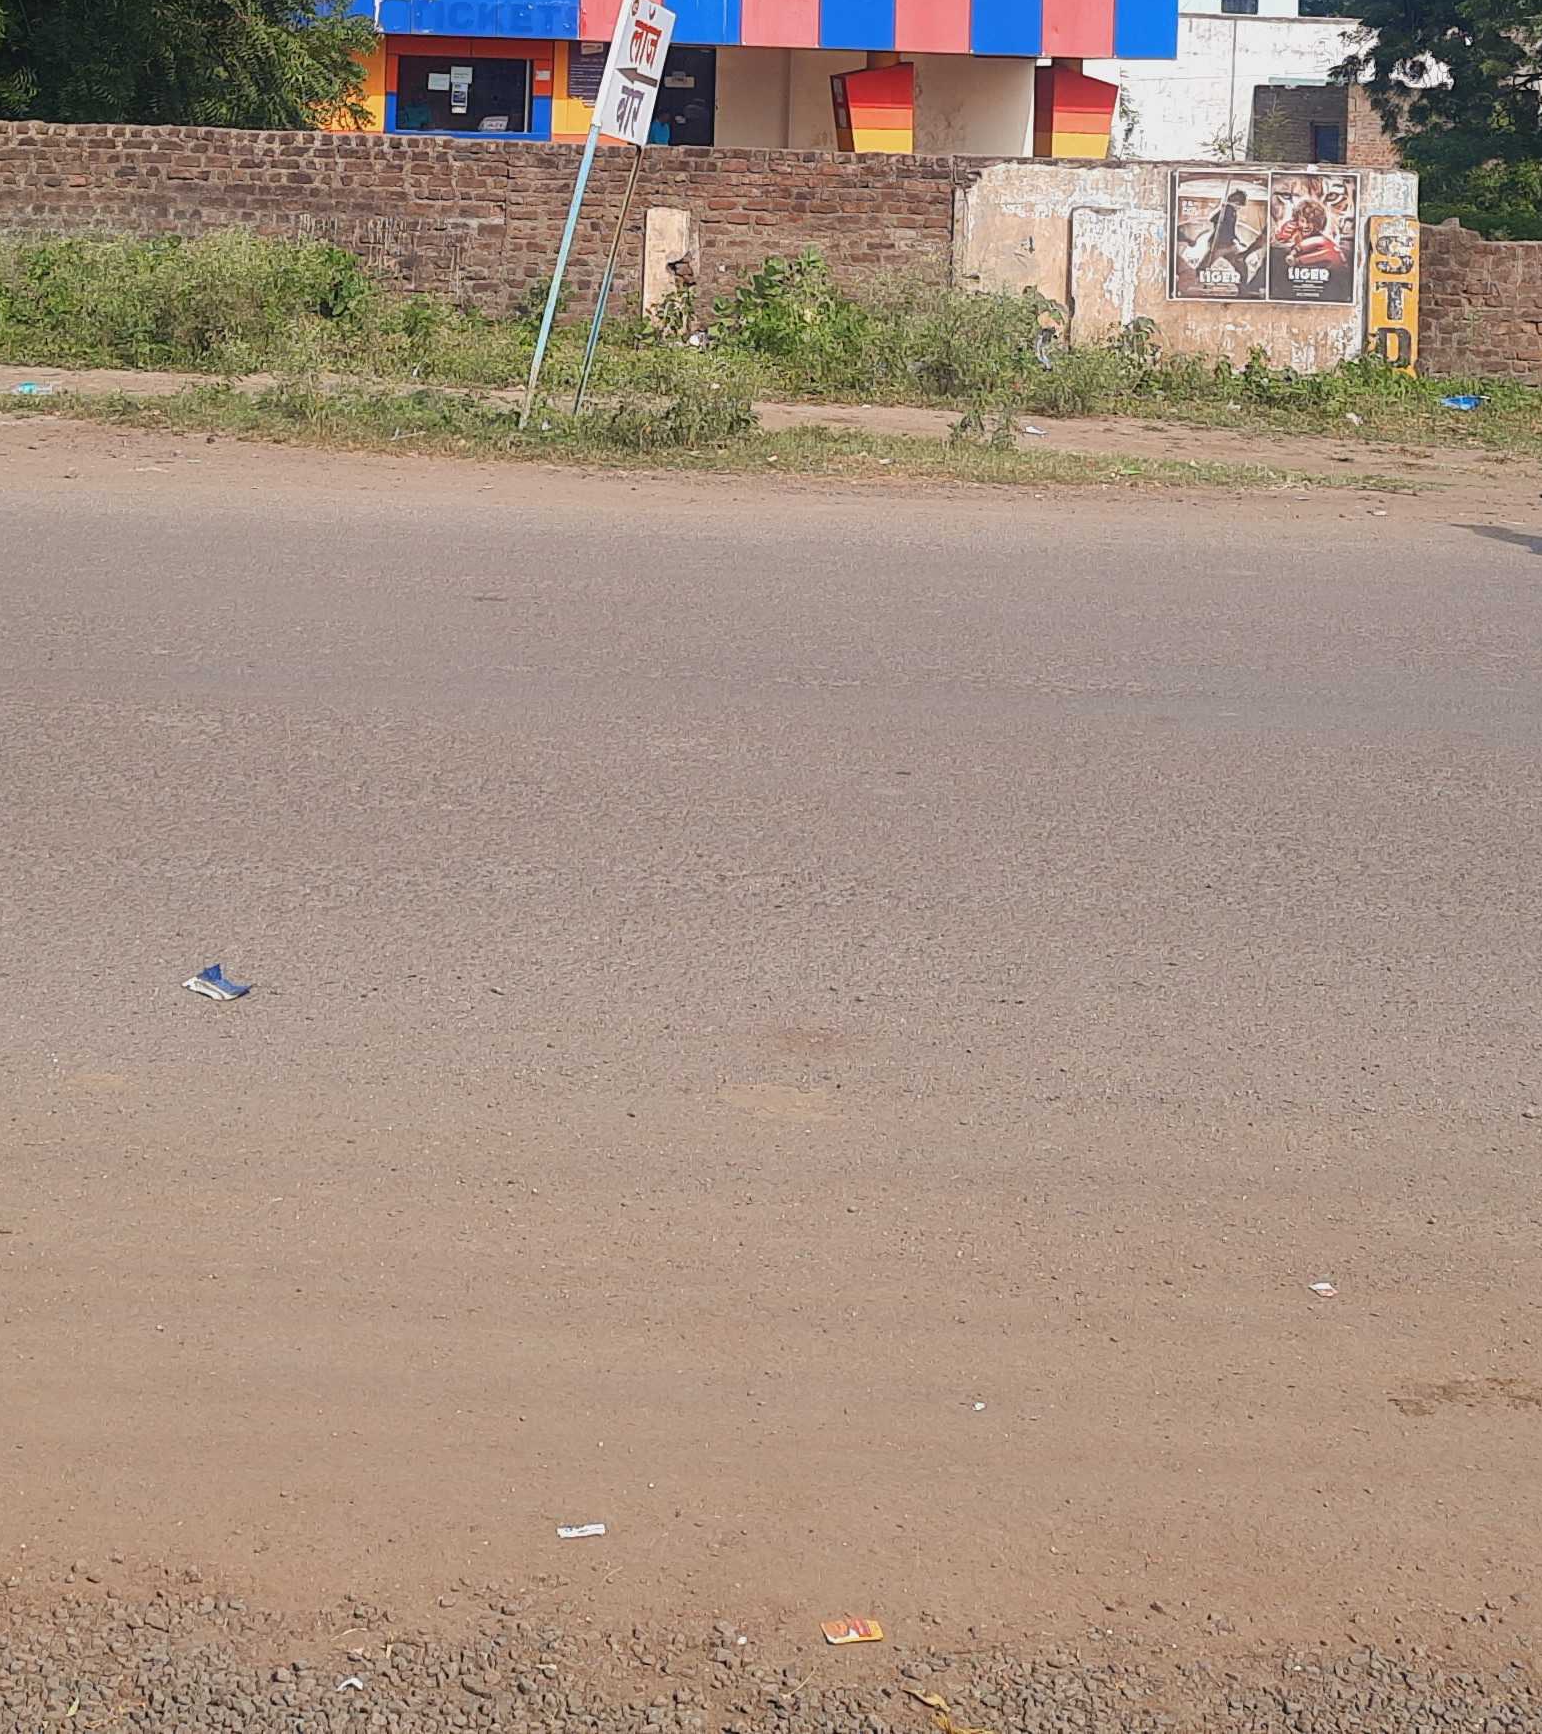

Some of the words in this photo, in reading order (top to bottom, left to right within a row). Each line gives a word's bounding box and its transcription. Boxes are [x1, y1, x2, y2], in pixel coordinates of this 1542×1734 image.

[1199, 270, 1241, 283] LIGER
[1288, 267, 1330, 281] LIGER
[1376, 235, 1414, 368] STD
